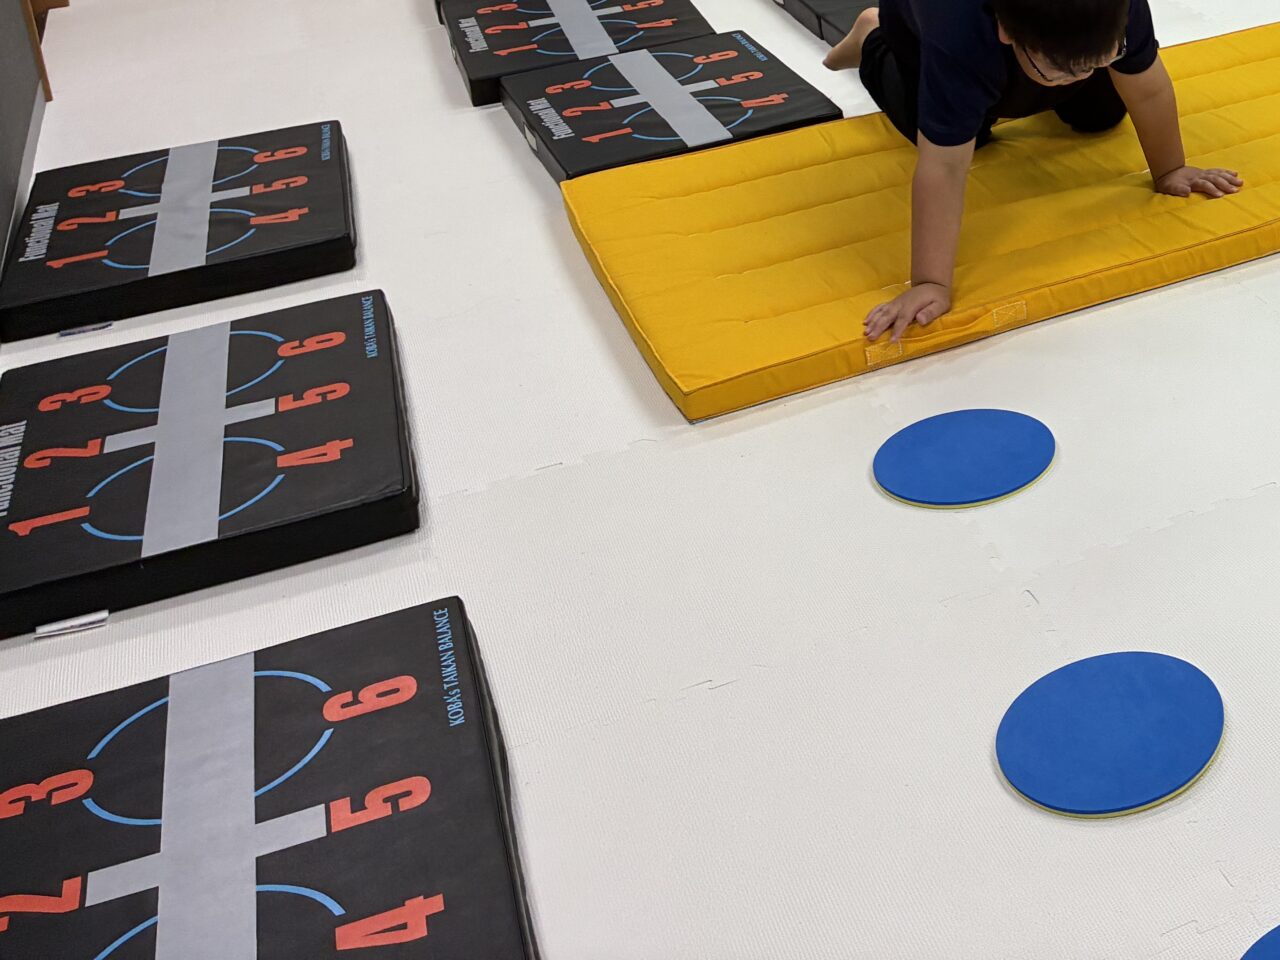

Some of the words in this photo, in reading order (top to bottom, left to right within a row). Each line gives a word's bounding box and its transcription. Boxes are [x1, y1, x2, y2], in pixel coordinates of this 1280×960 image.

[476, 2, 518, 14] 3
[622, 0, 664, 11] 5
[484, 21, 528, 34] 2
[635, 18, 678, 28] 4
[493, 44, 538, 56] 1
[693, 50, 738, 64] 6
[545, 79, 592, 94] 3
[716, 71, 763, 86] 5
[562, 100, 613, 117] 2
[740, 92, 789, 108] 4
[582, 127, 632, 143] 1
[254, 146, 307, 163] 6
[68, 180, 125, 198] 3
[252, 176, 308, 194] 5
[57, 211, 117, 230] 2
[250, 208, 308, 224] 4
[46, 250, 108, 269] 1
[277, 331, 346, 357] 6
[38, 385, 112, 412] 3
[278, 382, 350, 412] 5
[24, 439, 102, 468] 2
[277, 438, 353, 467] 4
[8, 506, 90, 536] 1
[433, 607, 452, 651] BALANCE
[439, 650, 460, 689] TAIKAN
[322, 675, 417, 722] 6
[442, 689, 465, 728] KOBA's
[0, 769, 94, 819] 3
[330, 775, 432, 832] 5
[335, 893, 444, 950] 4
